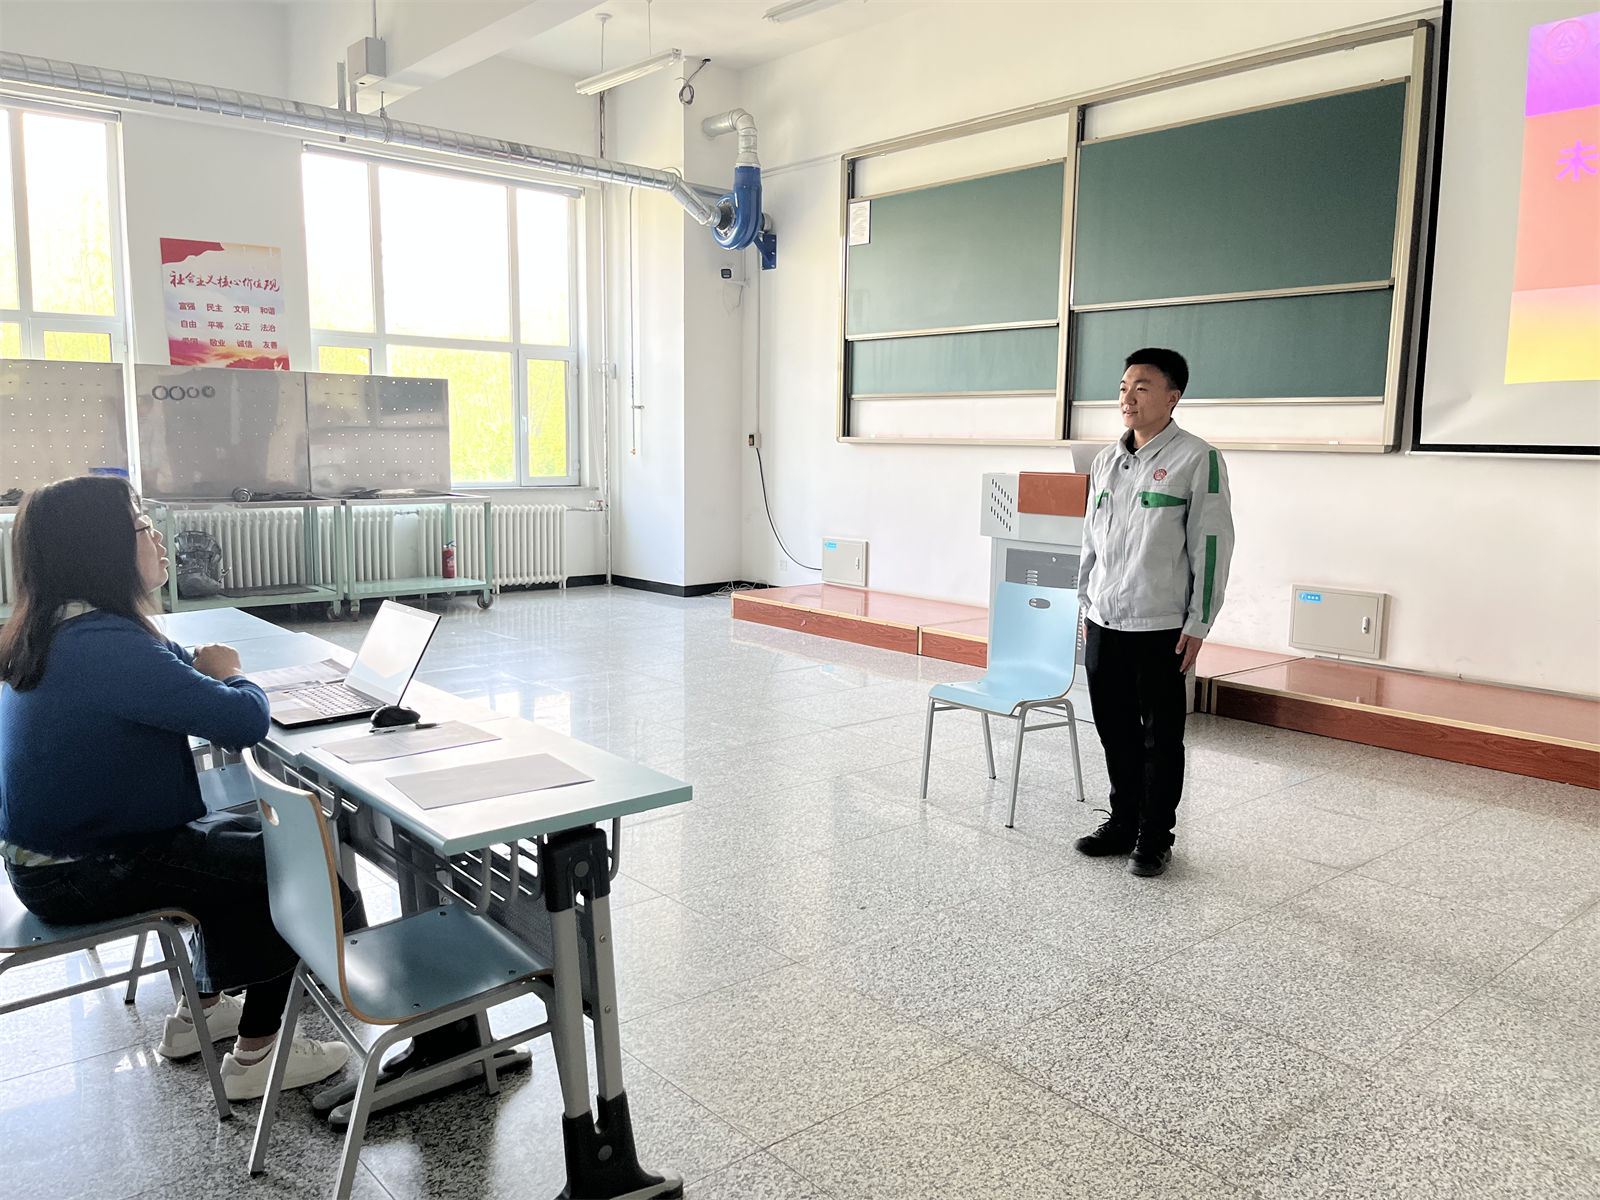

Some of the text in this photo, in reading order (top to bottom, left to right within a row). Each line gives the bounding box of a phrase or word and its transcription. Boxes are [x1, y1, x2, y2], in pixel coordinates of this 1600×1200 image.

[1555, 140, 1599, 181] 未
[206, 303, 223, 313] 民主
[233, 305, 250, 314] 文明
[180, 320, 197, 329] 自由
[234, 322, 251, 331] 公正
